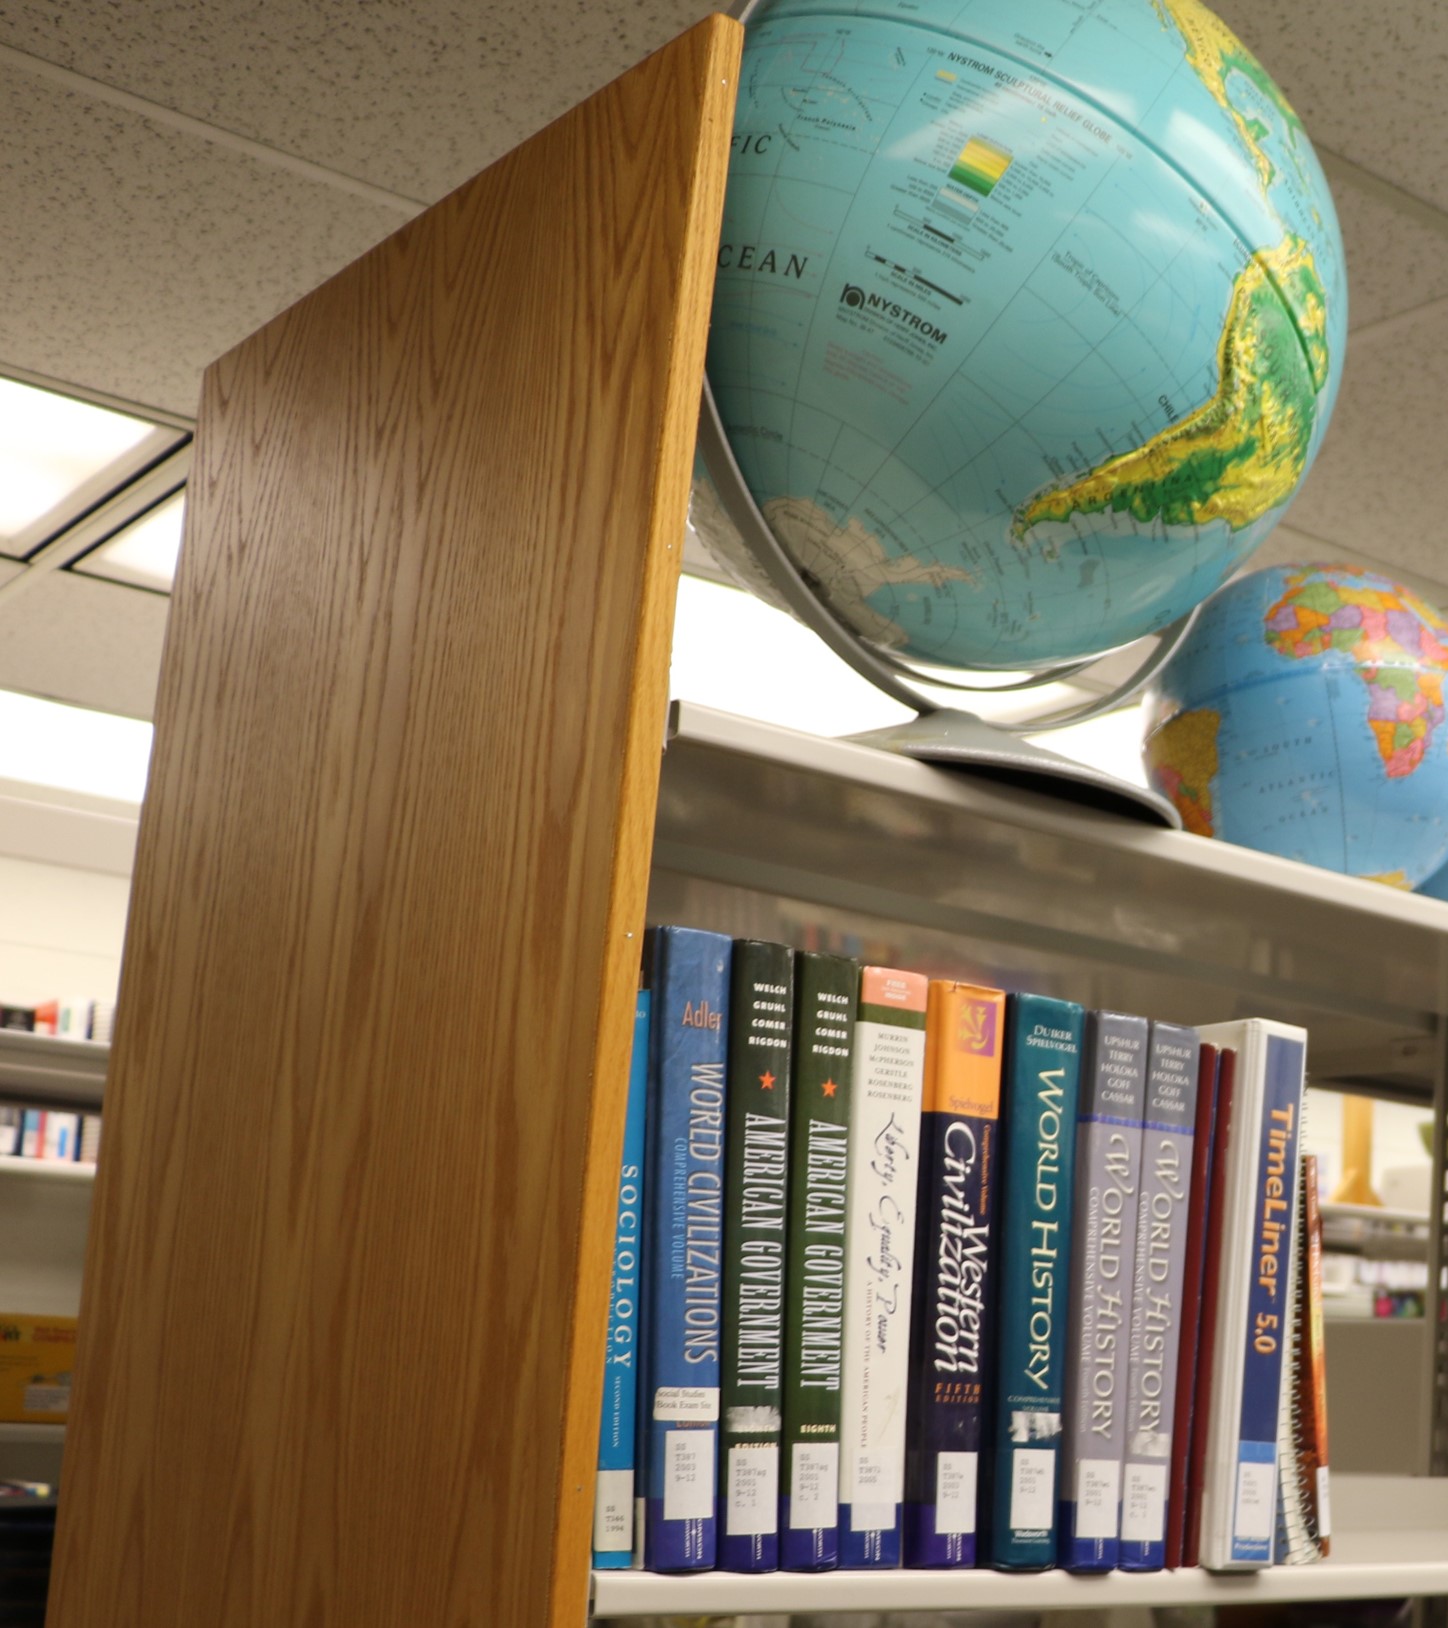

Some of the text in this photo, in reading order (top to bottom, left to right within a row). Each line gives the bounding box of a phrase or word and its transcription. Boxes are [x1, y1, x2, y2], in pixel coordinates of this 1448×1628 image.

[947, 52, 994, 76] NYSTROM
[994, 70, 1051, 105] SCULPTURAL
[1053, 100, 1083, 124] RELIEF
[1082, 119, 1112, 144] GLOBE
[867, 293, 948, 344] NYSTROM
[1158, 394, 1180, 424] CHILE
[754, 983, 787, 995] WELCH
[753, 1001, 786, 1012] GRUHL
[817, 992, 849, 1005] WELCH
[682, 1001, 722, 1030] Adler
[816, 1010, 848, 1022] GRUHL
[751, 1018, 786, 1030] COMER
[815, 1027, 847, 1039] COMER
[1033, 1024, 1073, 1041] DUIKER
[748, 1036, 787, 1049] RIGDON
[874, 1043, 910, 1054] JOHNSON
[1026, 1035, 1078, 1053] SPIELVOGEL
[1104, 1035, 1140, 1049] UPSHUR
[812, 1045, 849, 1057] RIGDON
[1109, 1050, 1134, 1062] TERRY
[1155, 1043, 1192, 1058] UPSHUR
[1101, 1062, 1138, 1078] HOLOKA
[1160, 1057, 1186, 1070] TERRY
[868, 1079, 913, 1091] ROSENBERG
[1107, 1077, 1131, 1090] GOFF
[1152, 1070, 1190, 1085] HOLOKA
[867, 1090, 912, 1102] ROSENBERG
[1101, 1090, 1135, 1105] CASSAR
[1158, 1084, 1182, 1098] GOFF
[1152, 1098, 1186, 1112] CASSAR
[741, 1112, 786, 1230] AMERICAN
[671, 1137, 687, 1280] COMPREHENSIVE VOLUME
[683, 1063, 725, 1365] WORLD CIVILIZATIONS
[1024, 1068, 1066, 1390] WORLD HISTORY
[1254, 1103, 1294, 1354] TimeLiner 5.0
[934, 1122, 977, 1373] Civilization
[1083, 1186, 1100, 1300] COMPREHENSIVE
[1133, 1191, 1150, 1305] COMPREHENSIVE
[800, 1119, 848, 1391] AMERICAN GOVERNMENT
[613, 1164, 639, 1368] SOCIOLOGY
[1091, 1133, 1135, 1439] WORLD HISTORY
[1139, 1140, 1184, 1440] WORLD HISTORY
[957, 1223, 990, 1373] Western
[737, 1241, 783, 1390] GOVERNMENT
[865, 1288, 873, 1327] HISTORY
[876, 1283, 899, 1354] Power
[1080, 1305, 1096, 1362] VOLUME
[1129, 1307, 1143, 1361] VOLUME
[863, 1344, 871, 1362] THE
[862, 1367, 871, 1412] AMERICAN
[934, 1382, 982, 1394] FIFTH
[655, 1400, 677, 1410] Book
[935, 1394, 981, 1404] EDITION
[612, 1411, 621, 1448] EDITION
[800, 1424, 836, 1434] EIGHTH
[860, 1415, 869, 1448] PEOPLE
[675, 1473, 696, 1482] 9-12
[735, 1489, 756, 1497] 9-12
[605, 1505, 616, 1513] SS
